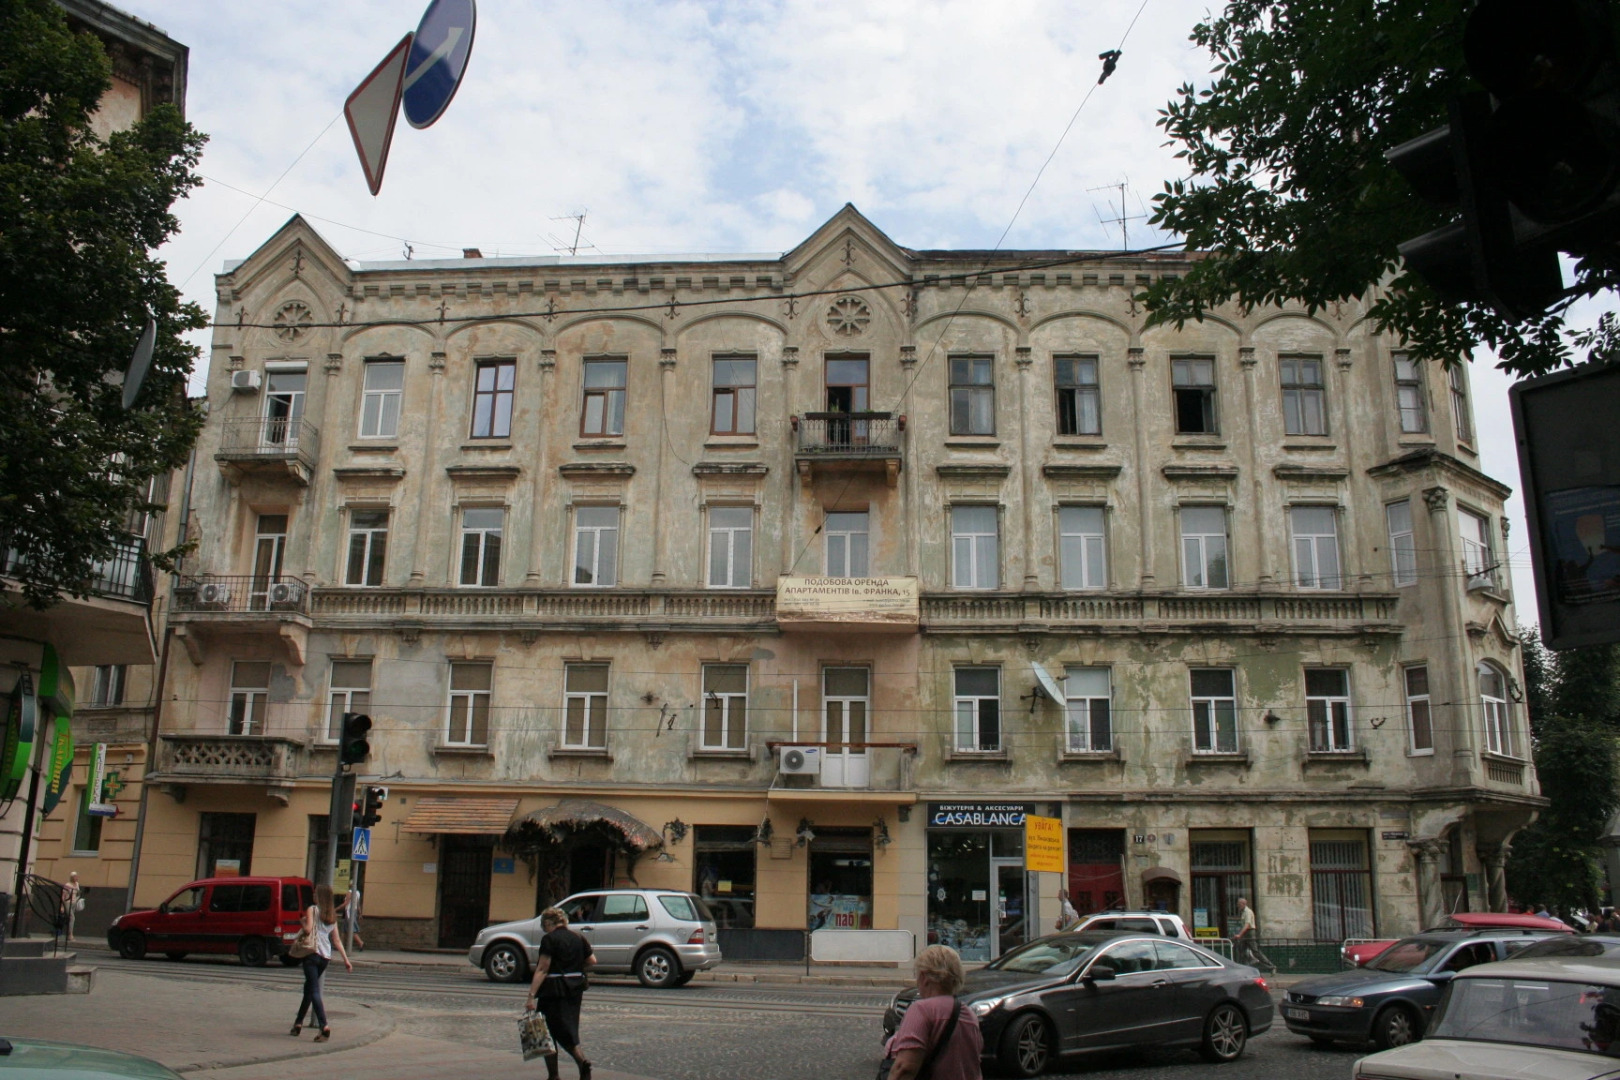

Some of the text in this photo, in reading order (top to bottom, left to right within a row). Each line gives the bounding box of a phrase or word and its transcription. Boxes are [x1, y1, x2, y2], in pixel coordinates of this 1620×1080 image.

[804, 578, 889, 587] ПОДОБОВА ОРЕНДА
[785, 587, 850, 595] АПАРТАМЕНТІВ
[863, 588, 901, 596] ФРАНКА,
[934, 812, 1027, 826] CASABLANCA
[1135, 835, 1143, 843] 17
